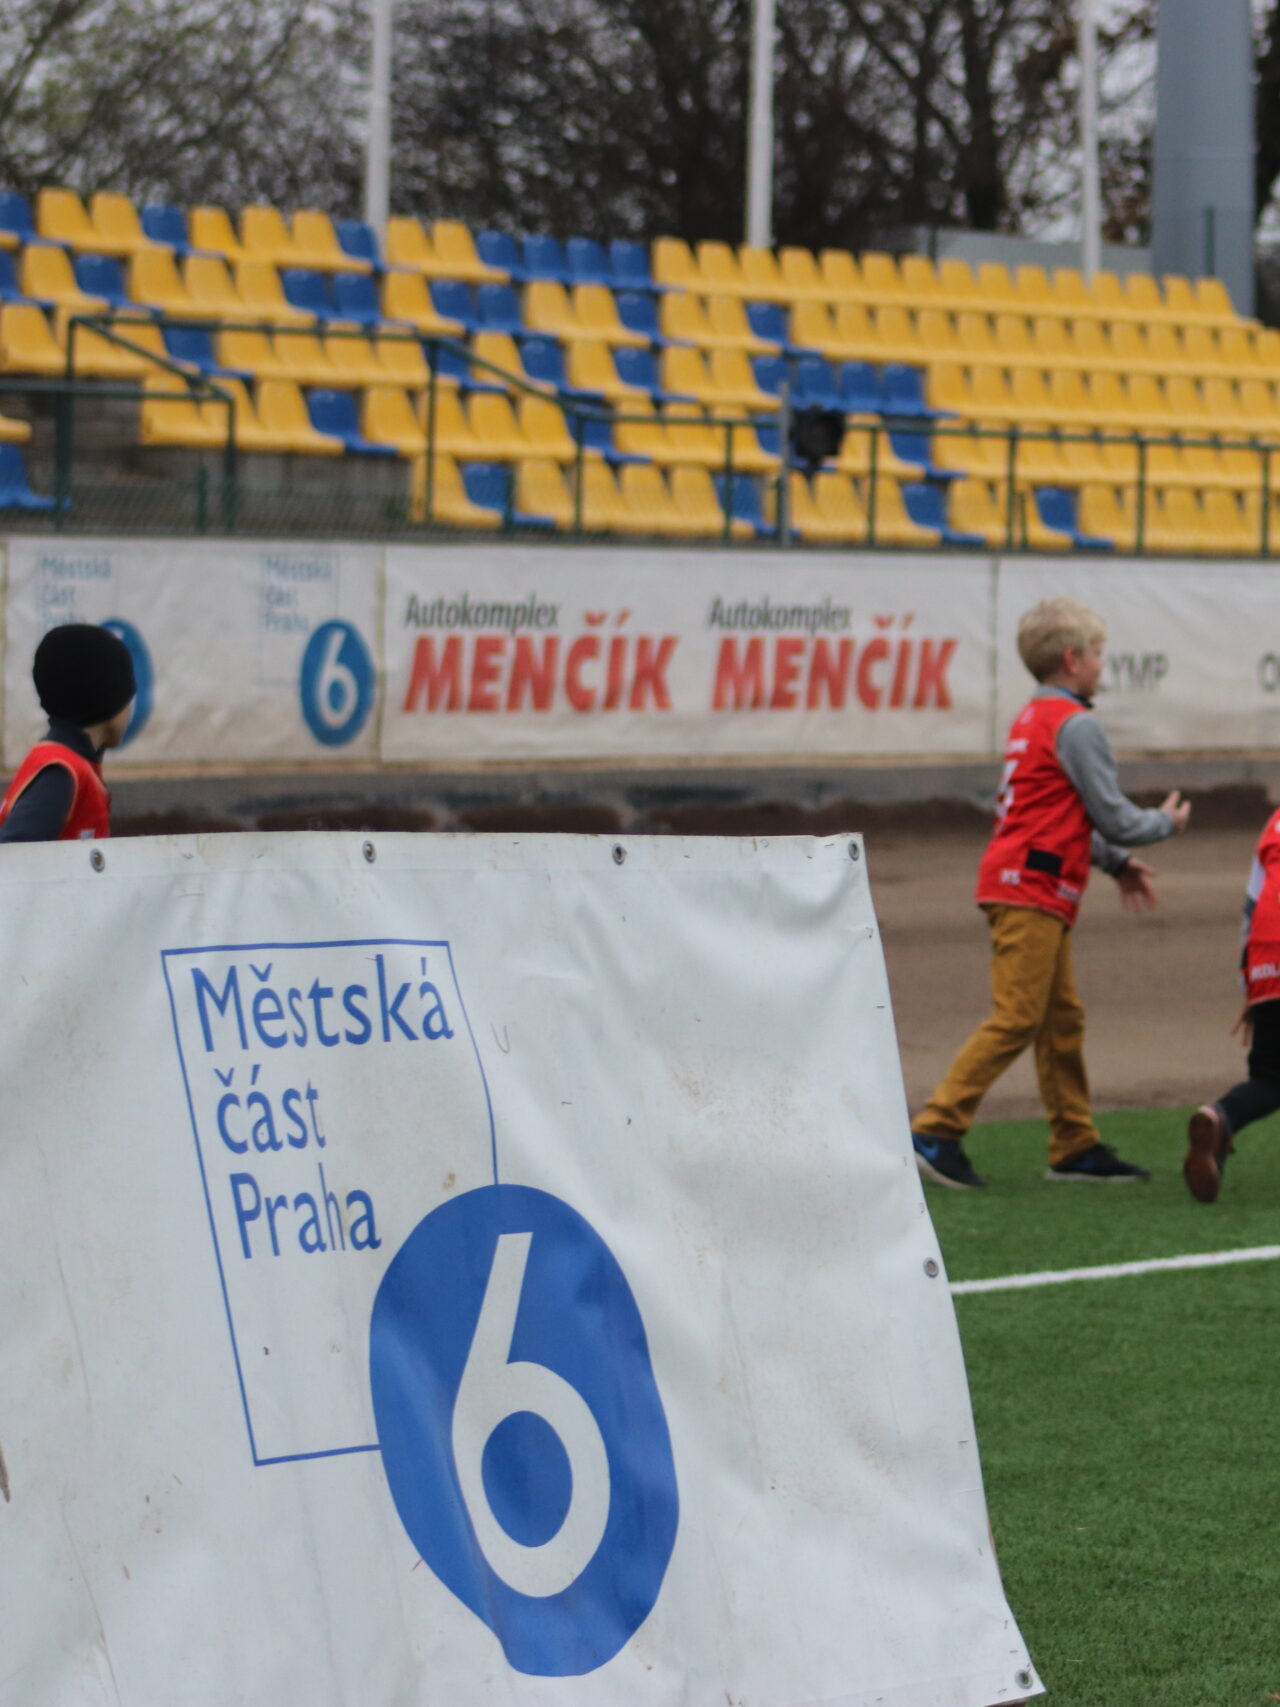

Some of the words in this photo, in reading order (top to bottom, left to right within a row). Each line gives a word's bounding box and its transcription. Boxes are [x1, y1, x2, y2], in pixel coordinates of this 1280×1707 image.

[403, 610, 680, 713] MENČÍK
[404, 594, 561, 635] Autokomplex
[708, 596, 853, 635] Autokomplex
[711, 612, 960, 711] MENČÍK
[314, 628, 358, 730] 6
[190, 953, 456, 1054] Městská
[213, 1063, 328, 1155] část
[228, 1161, 383, 1260] Praha
[450, 1230, 612, 1599] 6
